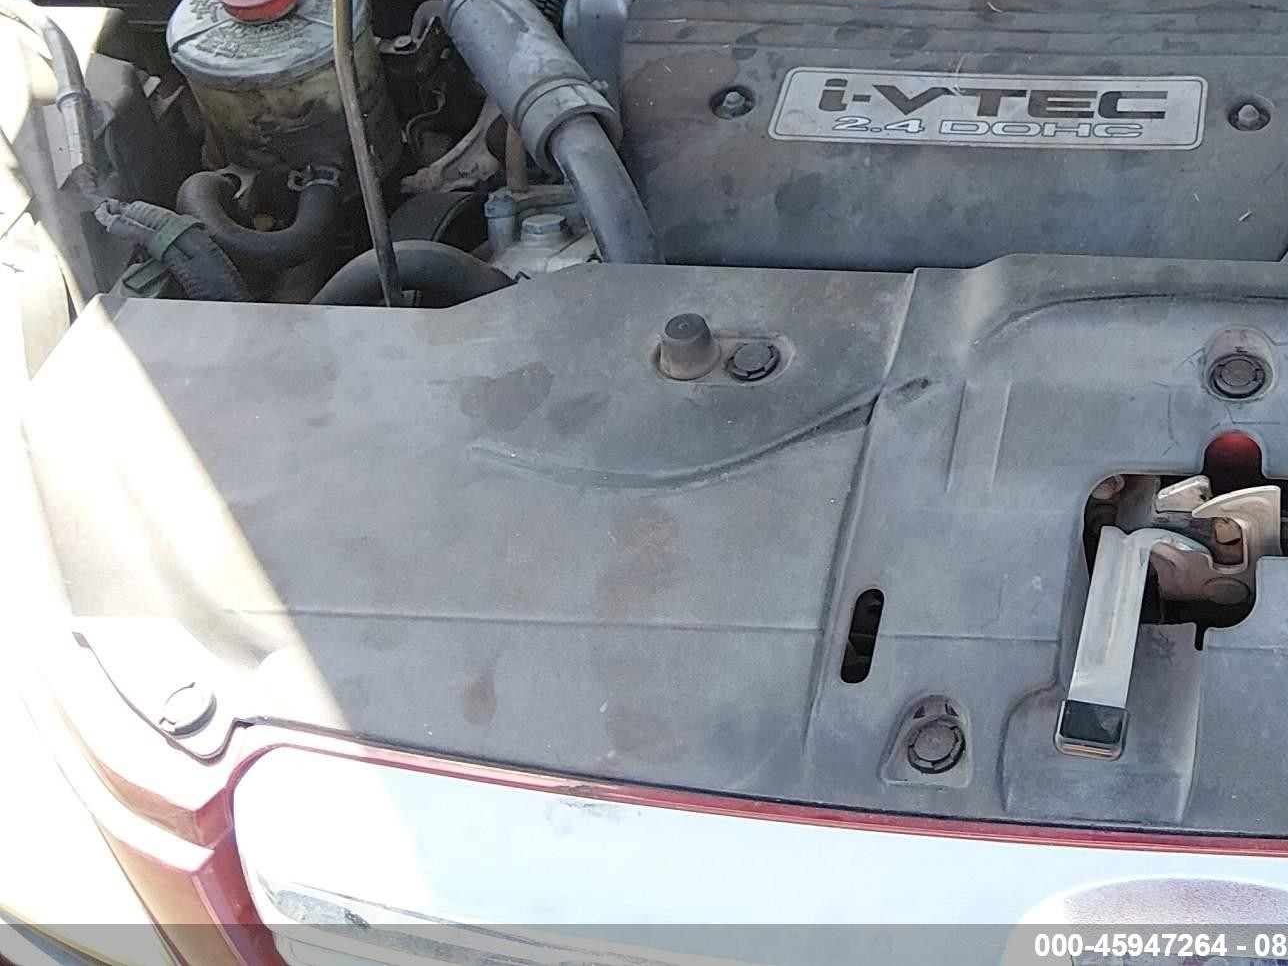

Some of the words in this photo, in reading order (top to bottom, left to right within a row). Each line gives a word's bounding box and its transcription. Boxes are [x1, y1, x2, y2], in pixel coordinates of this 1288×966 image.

[818, 77, 1169, 120] i-VTEC
[832, 115, 925, 134] 2.4
[939, 119, 1144, 139] DOHC
